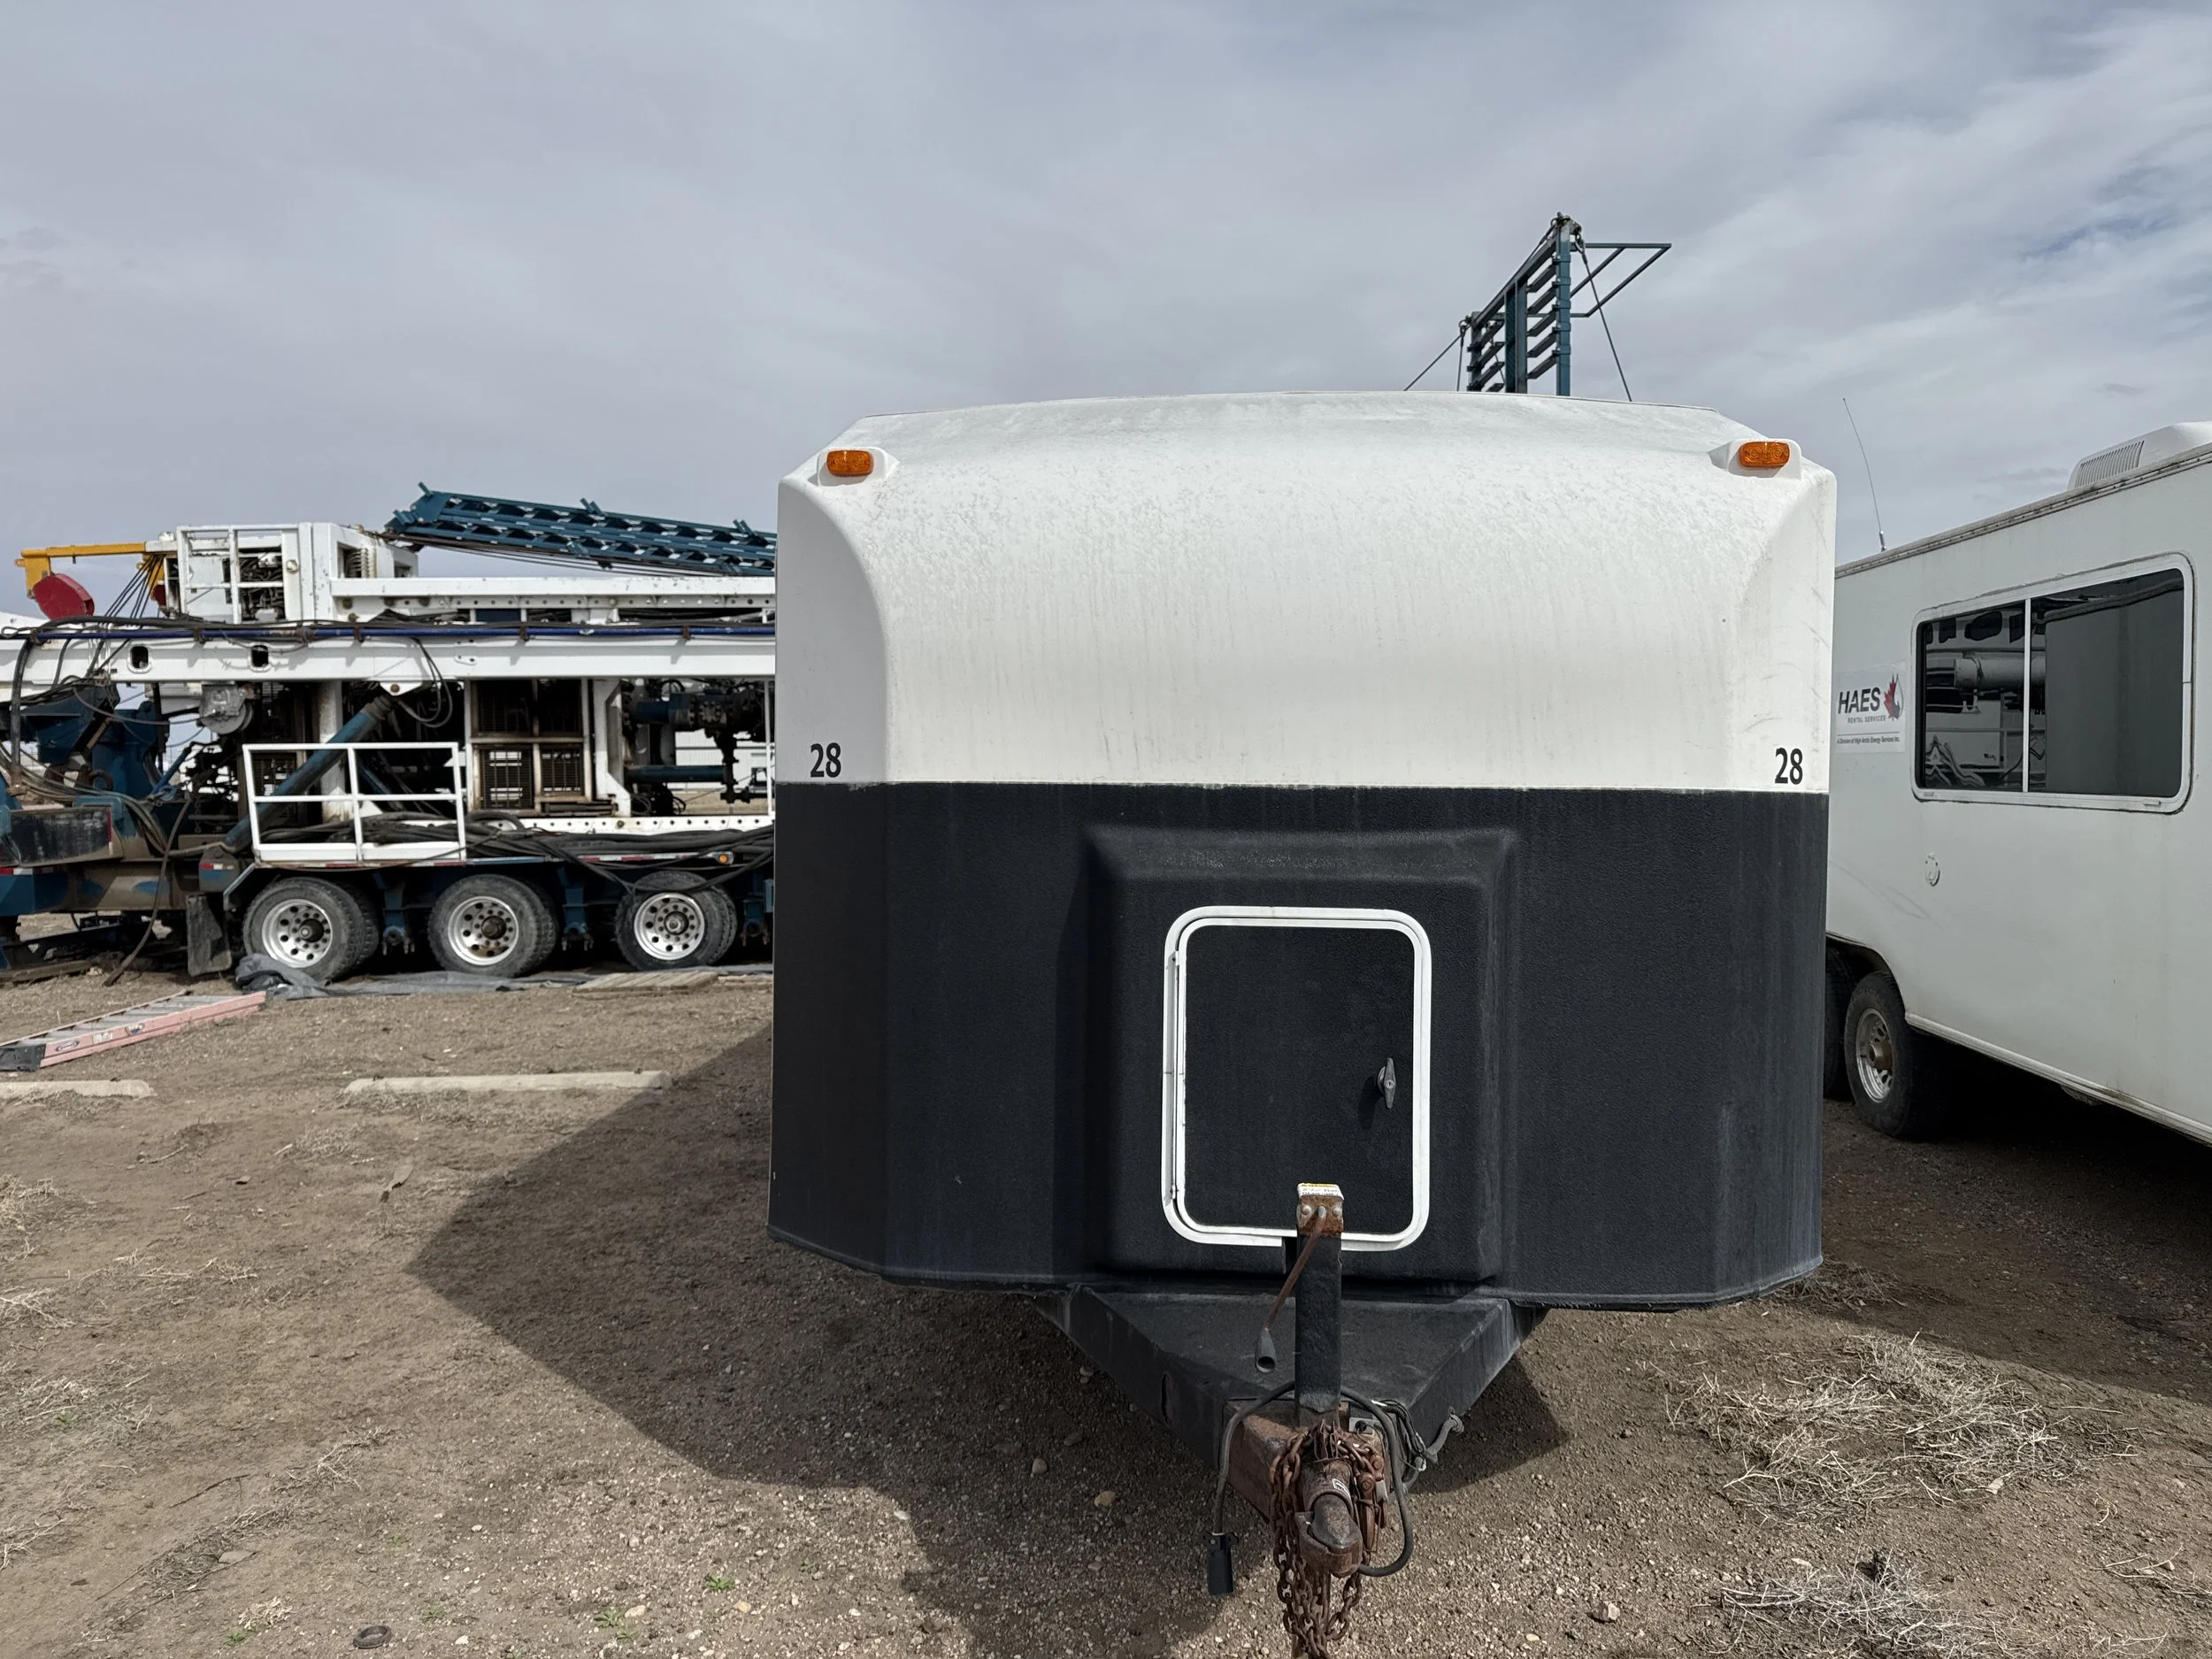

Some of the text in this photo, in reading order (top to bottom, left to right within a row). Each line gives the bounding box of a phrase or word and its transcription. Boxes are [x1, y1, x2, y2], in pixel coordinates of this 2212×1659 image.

[1838, 687, 1881, 714] HAES
[810, 742, 841, 778] 28
[1775, 747, 1803, 785] 28
